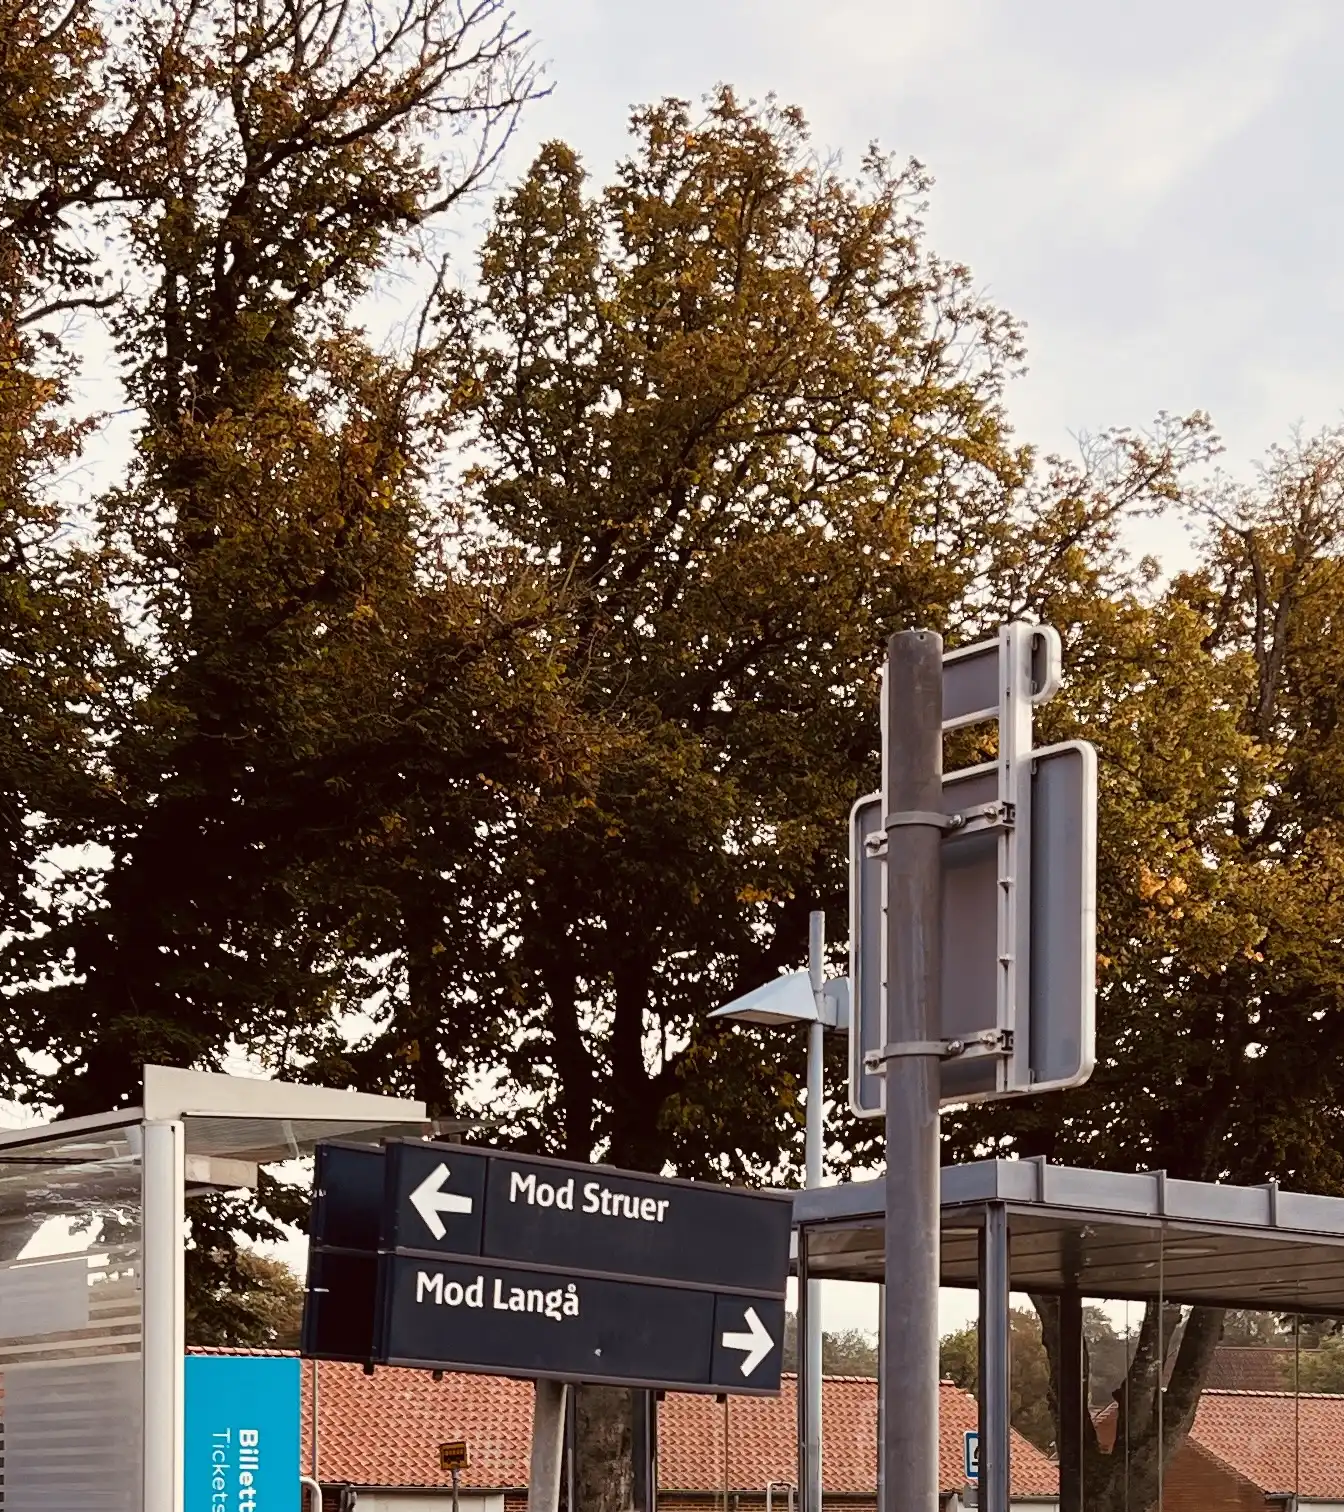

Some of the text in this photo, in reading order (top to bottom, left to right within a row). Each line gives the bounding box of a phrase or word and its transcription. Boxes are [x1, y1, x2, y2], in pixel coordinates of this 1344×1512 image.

[509, 1171, 670, 1223] Mod Struer
[416, 1271, 580, 1322] Mod Langå
